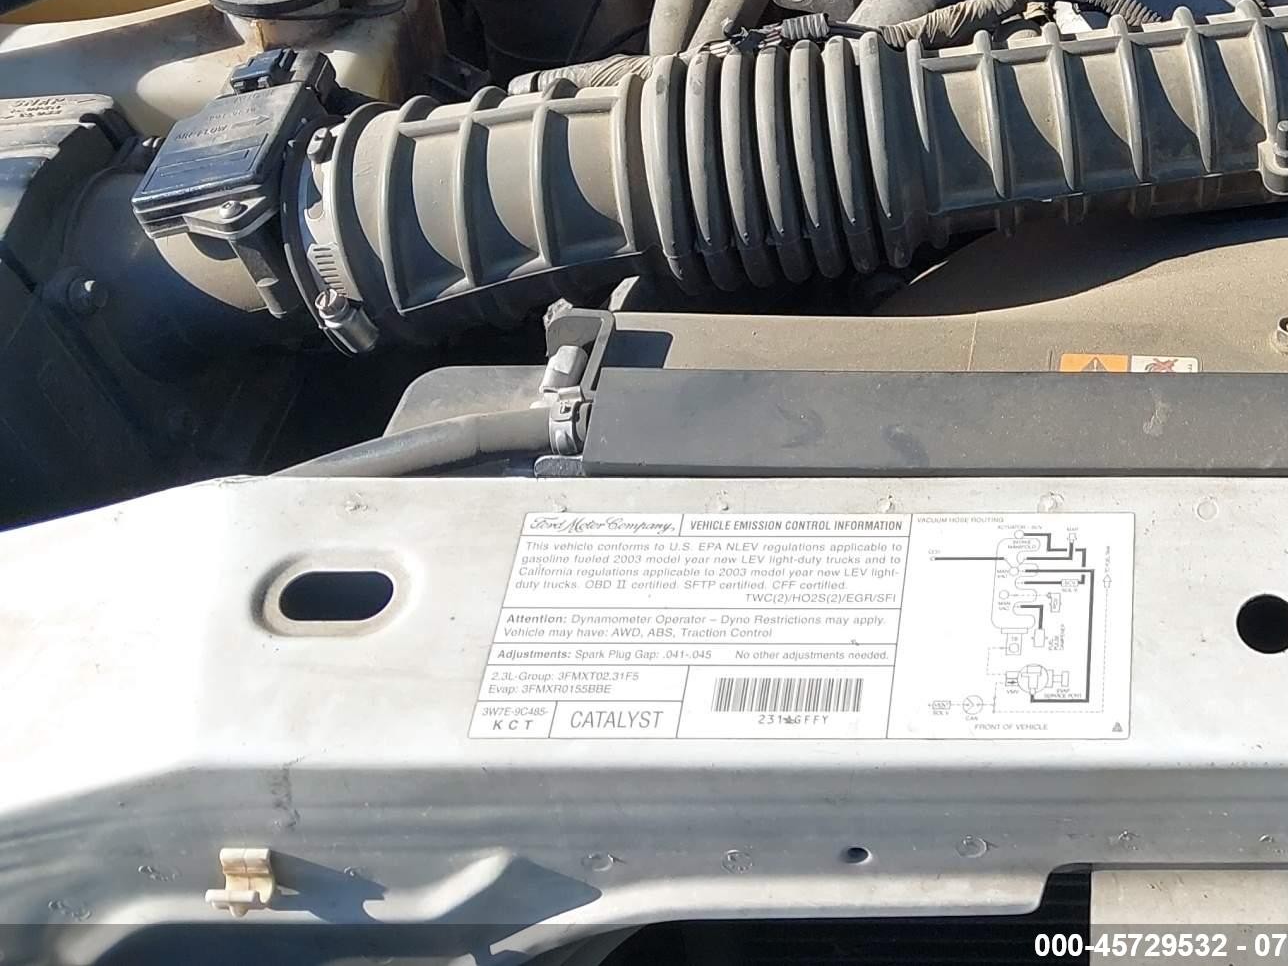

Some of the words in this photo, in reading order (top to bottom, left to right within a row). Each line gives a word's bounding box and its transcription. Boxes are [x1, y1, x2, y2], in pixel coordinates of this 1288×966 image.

[690, 521, 731, 530] VEHICLE
[734, 521, 781, 530] EMISSION
[785, 521, 830, 530] CONTROL
[834, 521, 902, 531] INFORMATION
[527, 541, 548, 551] This
[554, 542, 593, 551] vehicle
[598, 542, 649, 551] conforms
[654, 543, 664, 551] to
[698, 543, 721, 551] EPA
[726, 543, 758, 551] NLEV
[763, 543, 825, 553] regulations
[830, 543, 886, 553] applicable
[892, 544, 902, 552] to
[522, 555, 569, 565] gasoline
[574, 555, 609, 563] fueled
[614, 555, 642, 563] 2003
[646, 555, 680, 563] model
[742, 556, 764, 564] LEV
[769, 556, 821, 566] light-duty
[827, 556, 860, 564] trucks
[865, 556, 885, 564] and
[507, 615, 566, 623] Attention:
[571, 615, 650, 625] Dynamometer
[656, 615, 706, 626] Operator
[721, 615, 750, 626] Dyno
[754, 615, 821, 624] Restrictions
[826, 618, 848, 626] may
[853, 616, 885, 626] apply.
[498, 650, 571, 660] Adjustments:
[575, 650, 604, 660] Spark
[609, 650, 631, 660] Plug
[635, 650, 659, 660] Gap:
[736, 651, 749, 659] No
[753, 651, 779, 659] other
[783, 651, 844, 661] adjustments
[848, 651, 888, 659] needed.
[571, 711, 663, 728] CATALYST
[759, 715, 829, 725] 231GFFY
